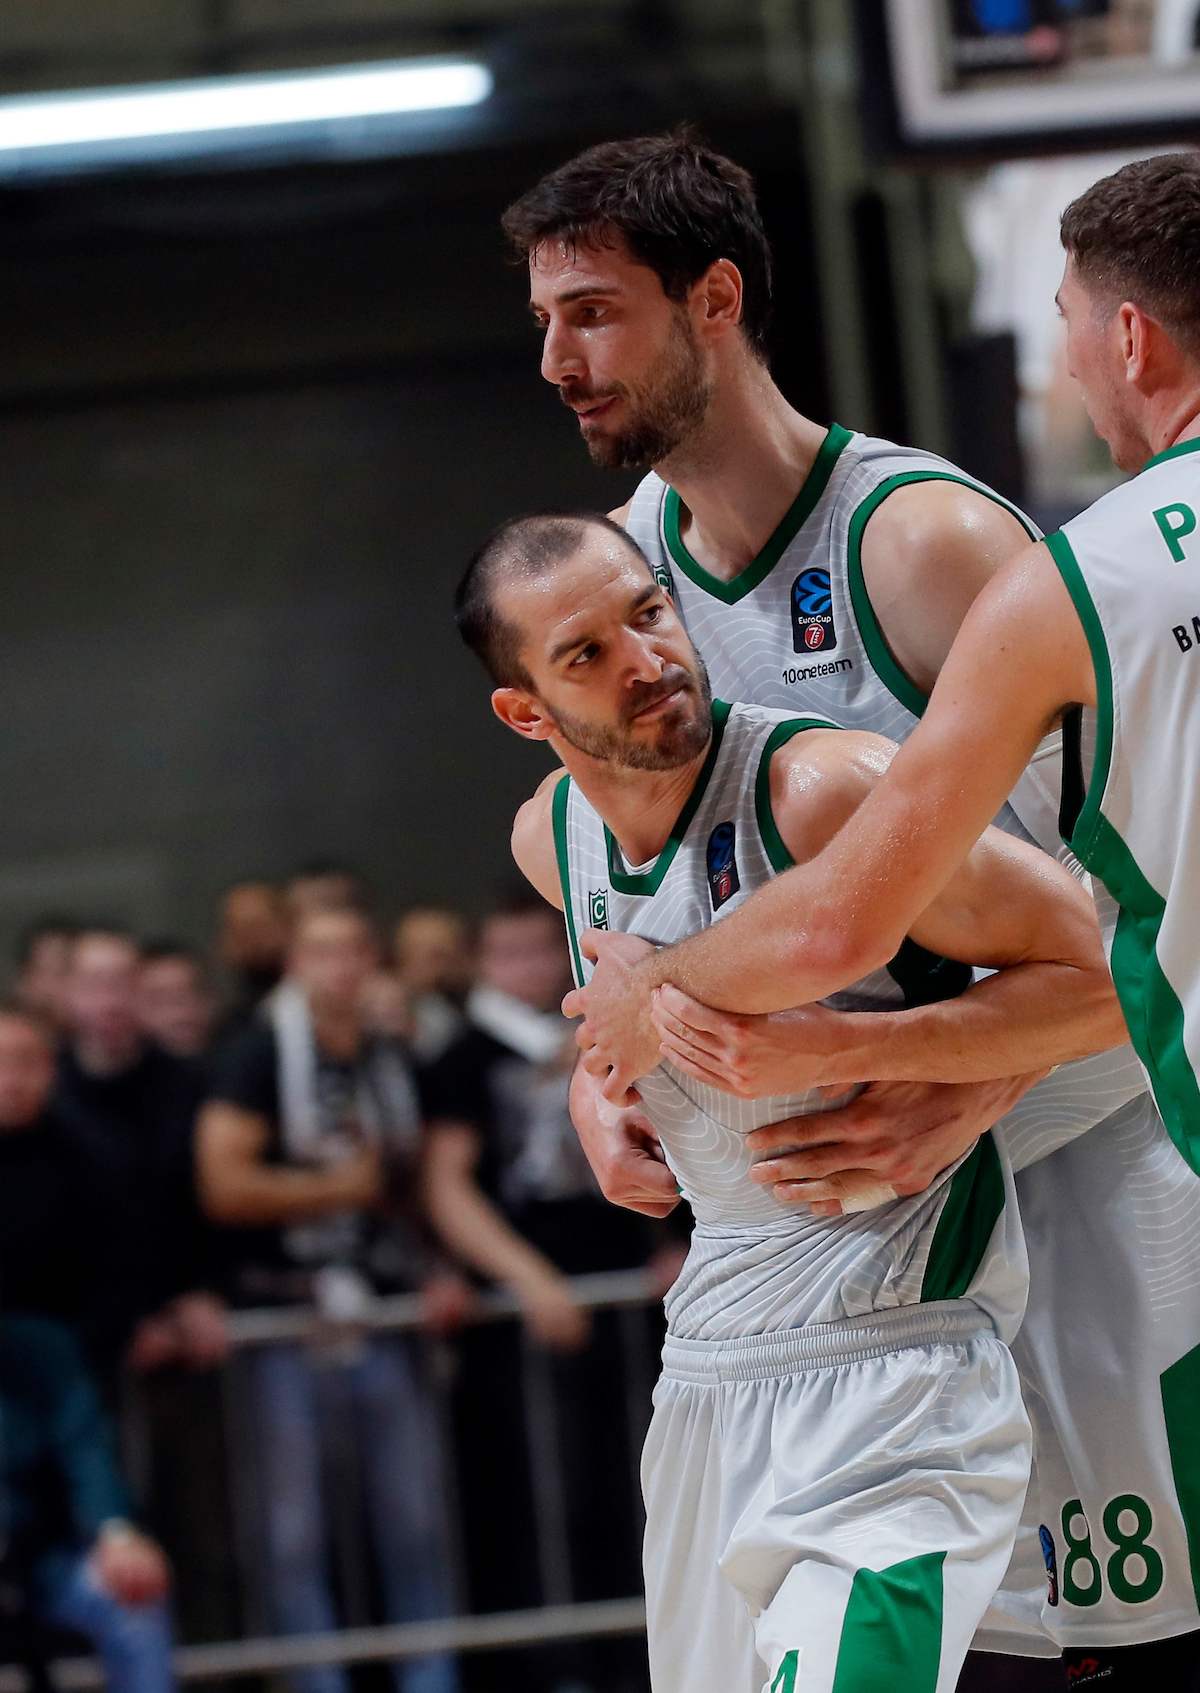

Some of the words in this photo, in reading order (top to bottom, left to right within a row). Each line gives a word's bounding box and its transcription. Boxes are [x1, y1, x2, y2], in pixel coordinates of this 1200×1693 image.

[797, 614, 832, 625] EuroCup
[781, 658, 853, 686] 10oneteam
[1060, 1493, 1164, 1608] 88
